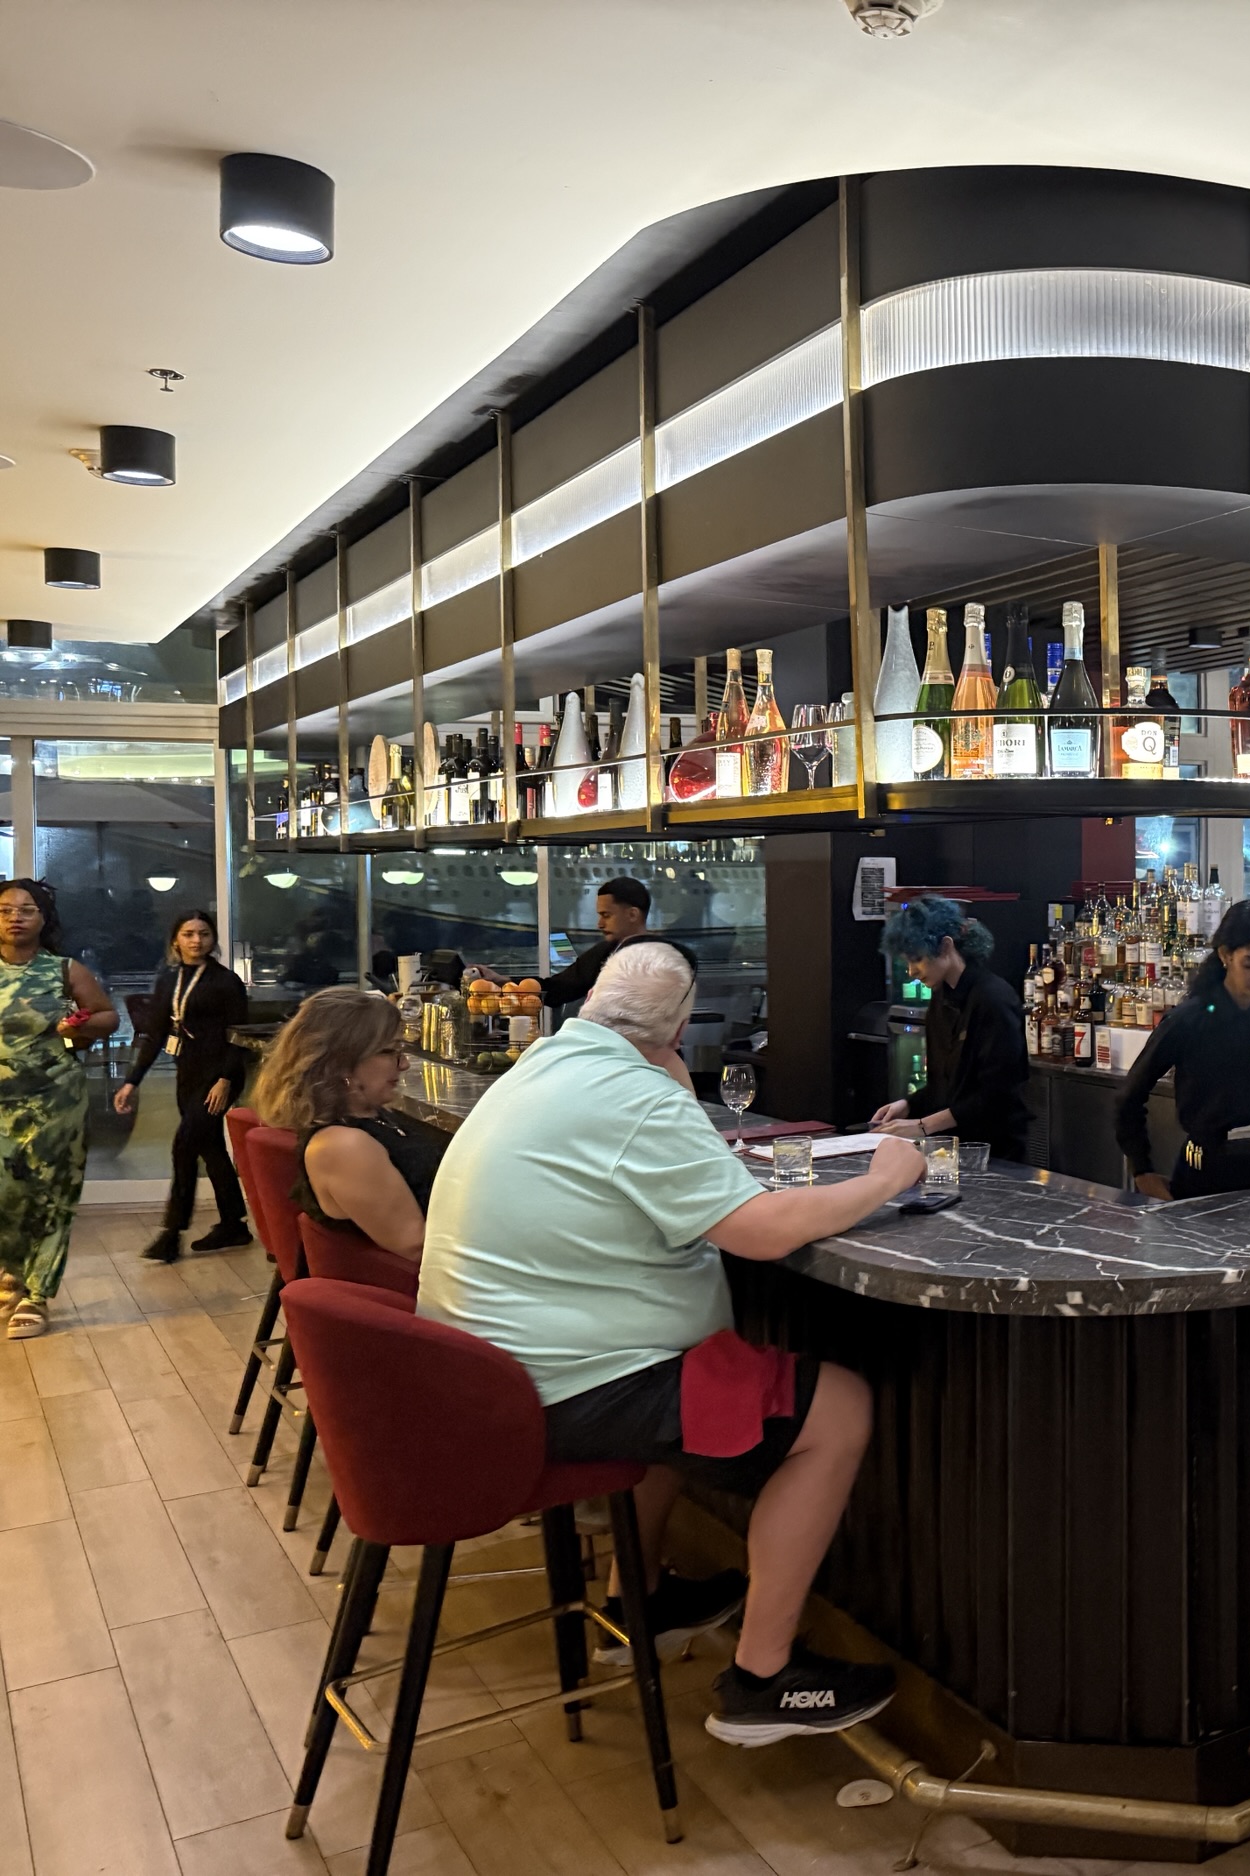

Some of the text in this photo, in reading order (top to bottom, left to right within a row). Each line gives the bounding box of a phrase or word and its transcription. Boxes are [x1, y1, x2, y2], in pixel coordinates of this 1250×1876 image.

[1143, 736, 1157, 756] Q
[1074, 1031, 1087, 1056] 7
[779, 1690, 836, 1709] HOKA
